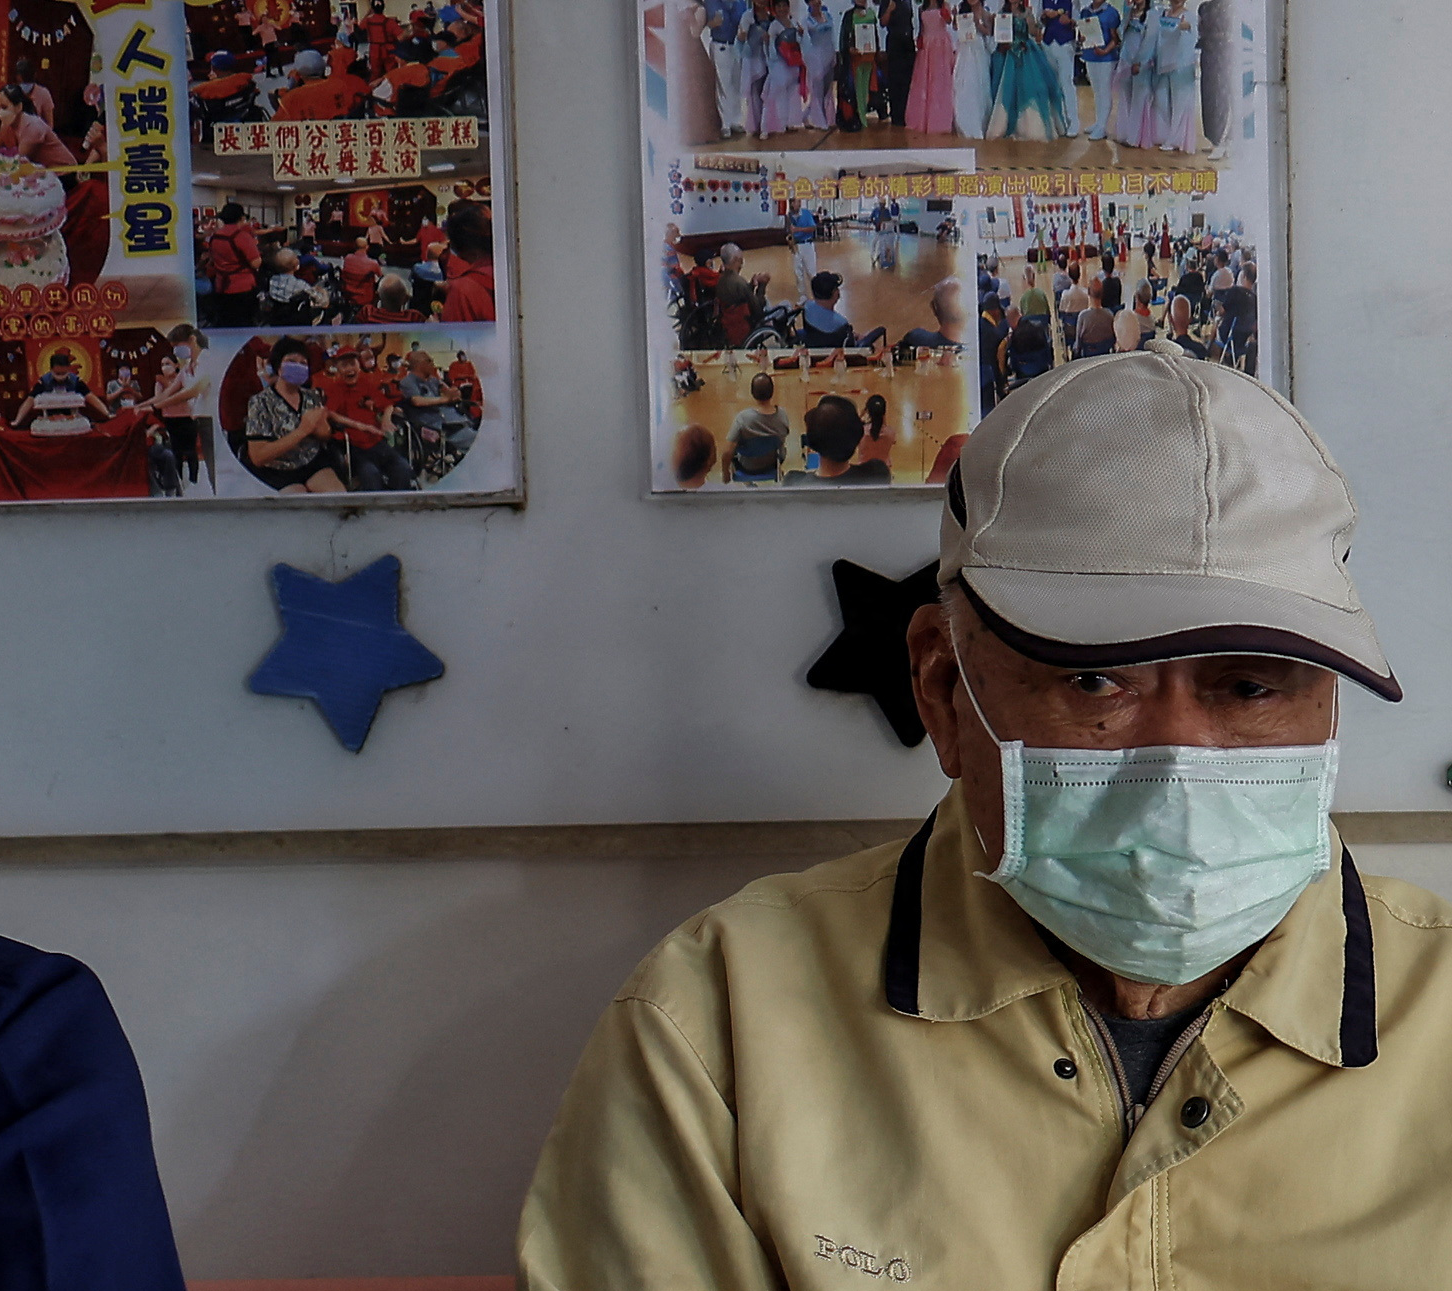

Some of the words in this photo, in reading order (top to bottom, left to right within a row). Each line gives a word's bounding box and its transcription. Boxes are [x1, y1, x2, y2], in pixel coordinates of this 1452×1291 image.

[115, 27, 173, 254] 人瑞壽星
[217, 117, 477, 152] 長輩們分享百歲蛋糕
[275, 150, 419, 177] 及熱舞表演
[813, 1233, 913, 1284] POLO
